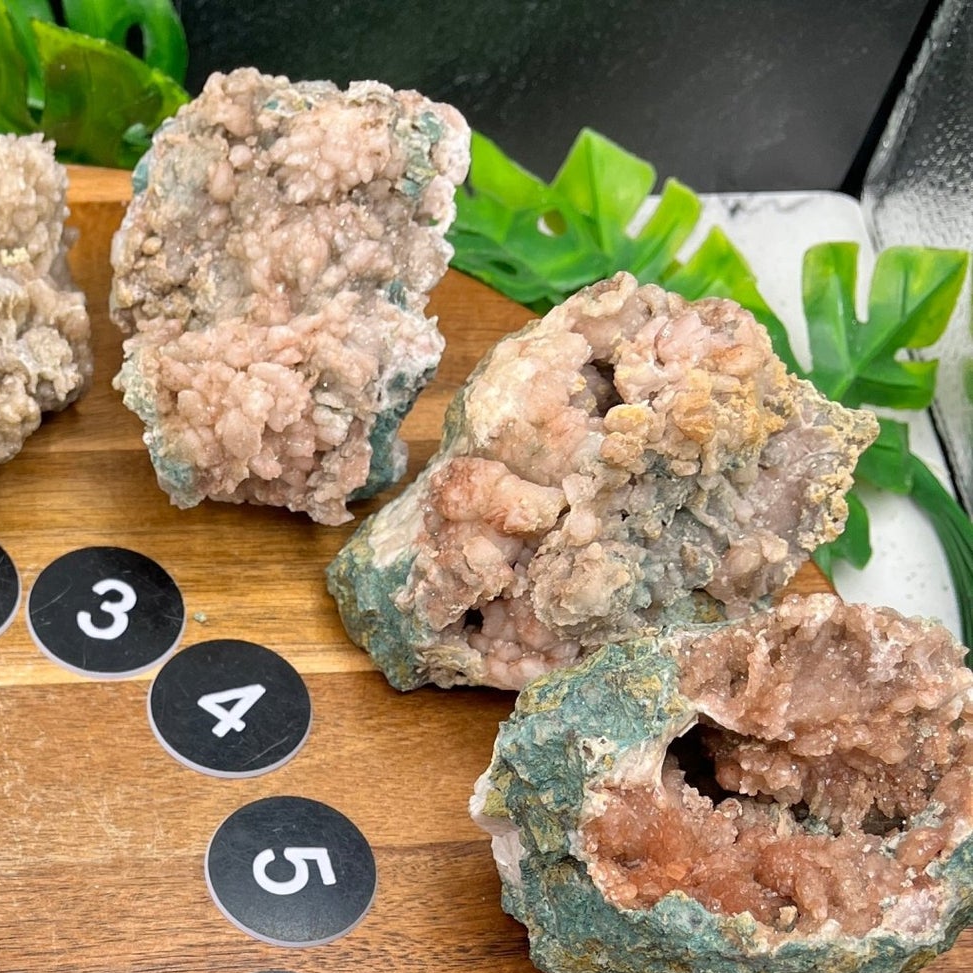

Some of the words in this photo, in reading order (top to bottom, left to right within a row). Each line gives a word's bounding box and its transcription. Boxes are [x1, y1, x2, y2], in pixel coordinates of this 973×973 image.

[78, 580, 136, 639] 3
[197, 684, 265, 737] 4
[253, 848, 337, 896] 5
